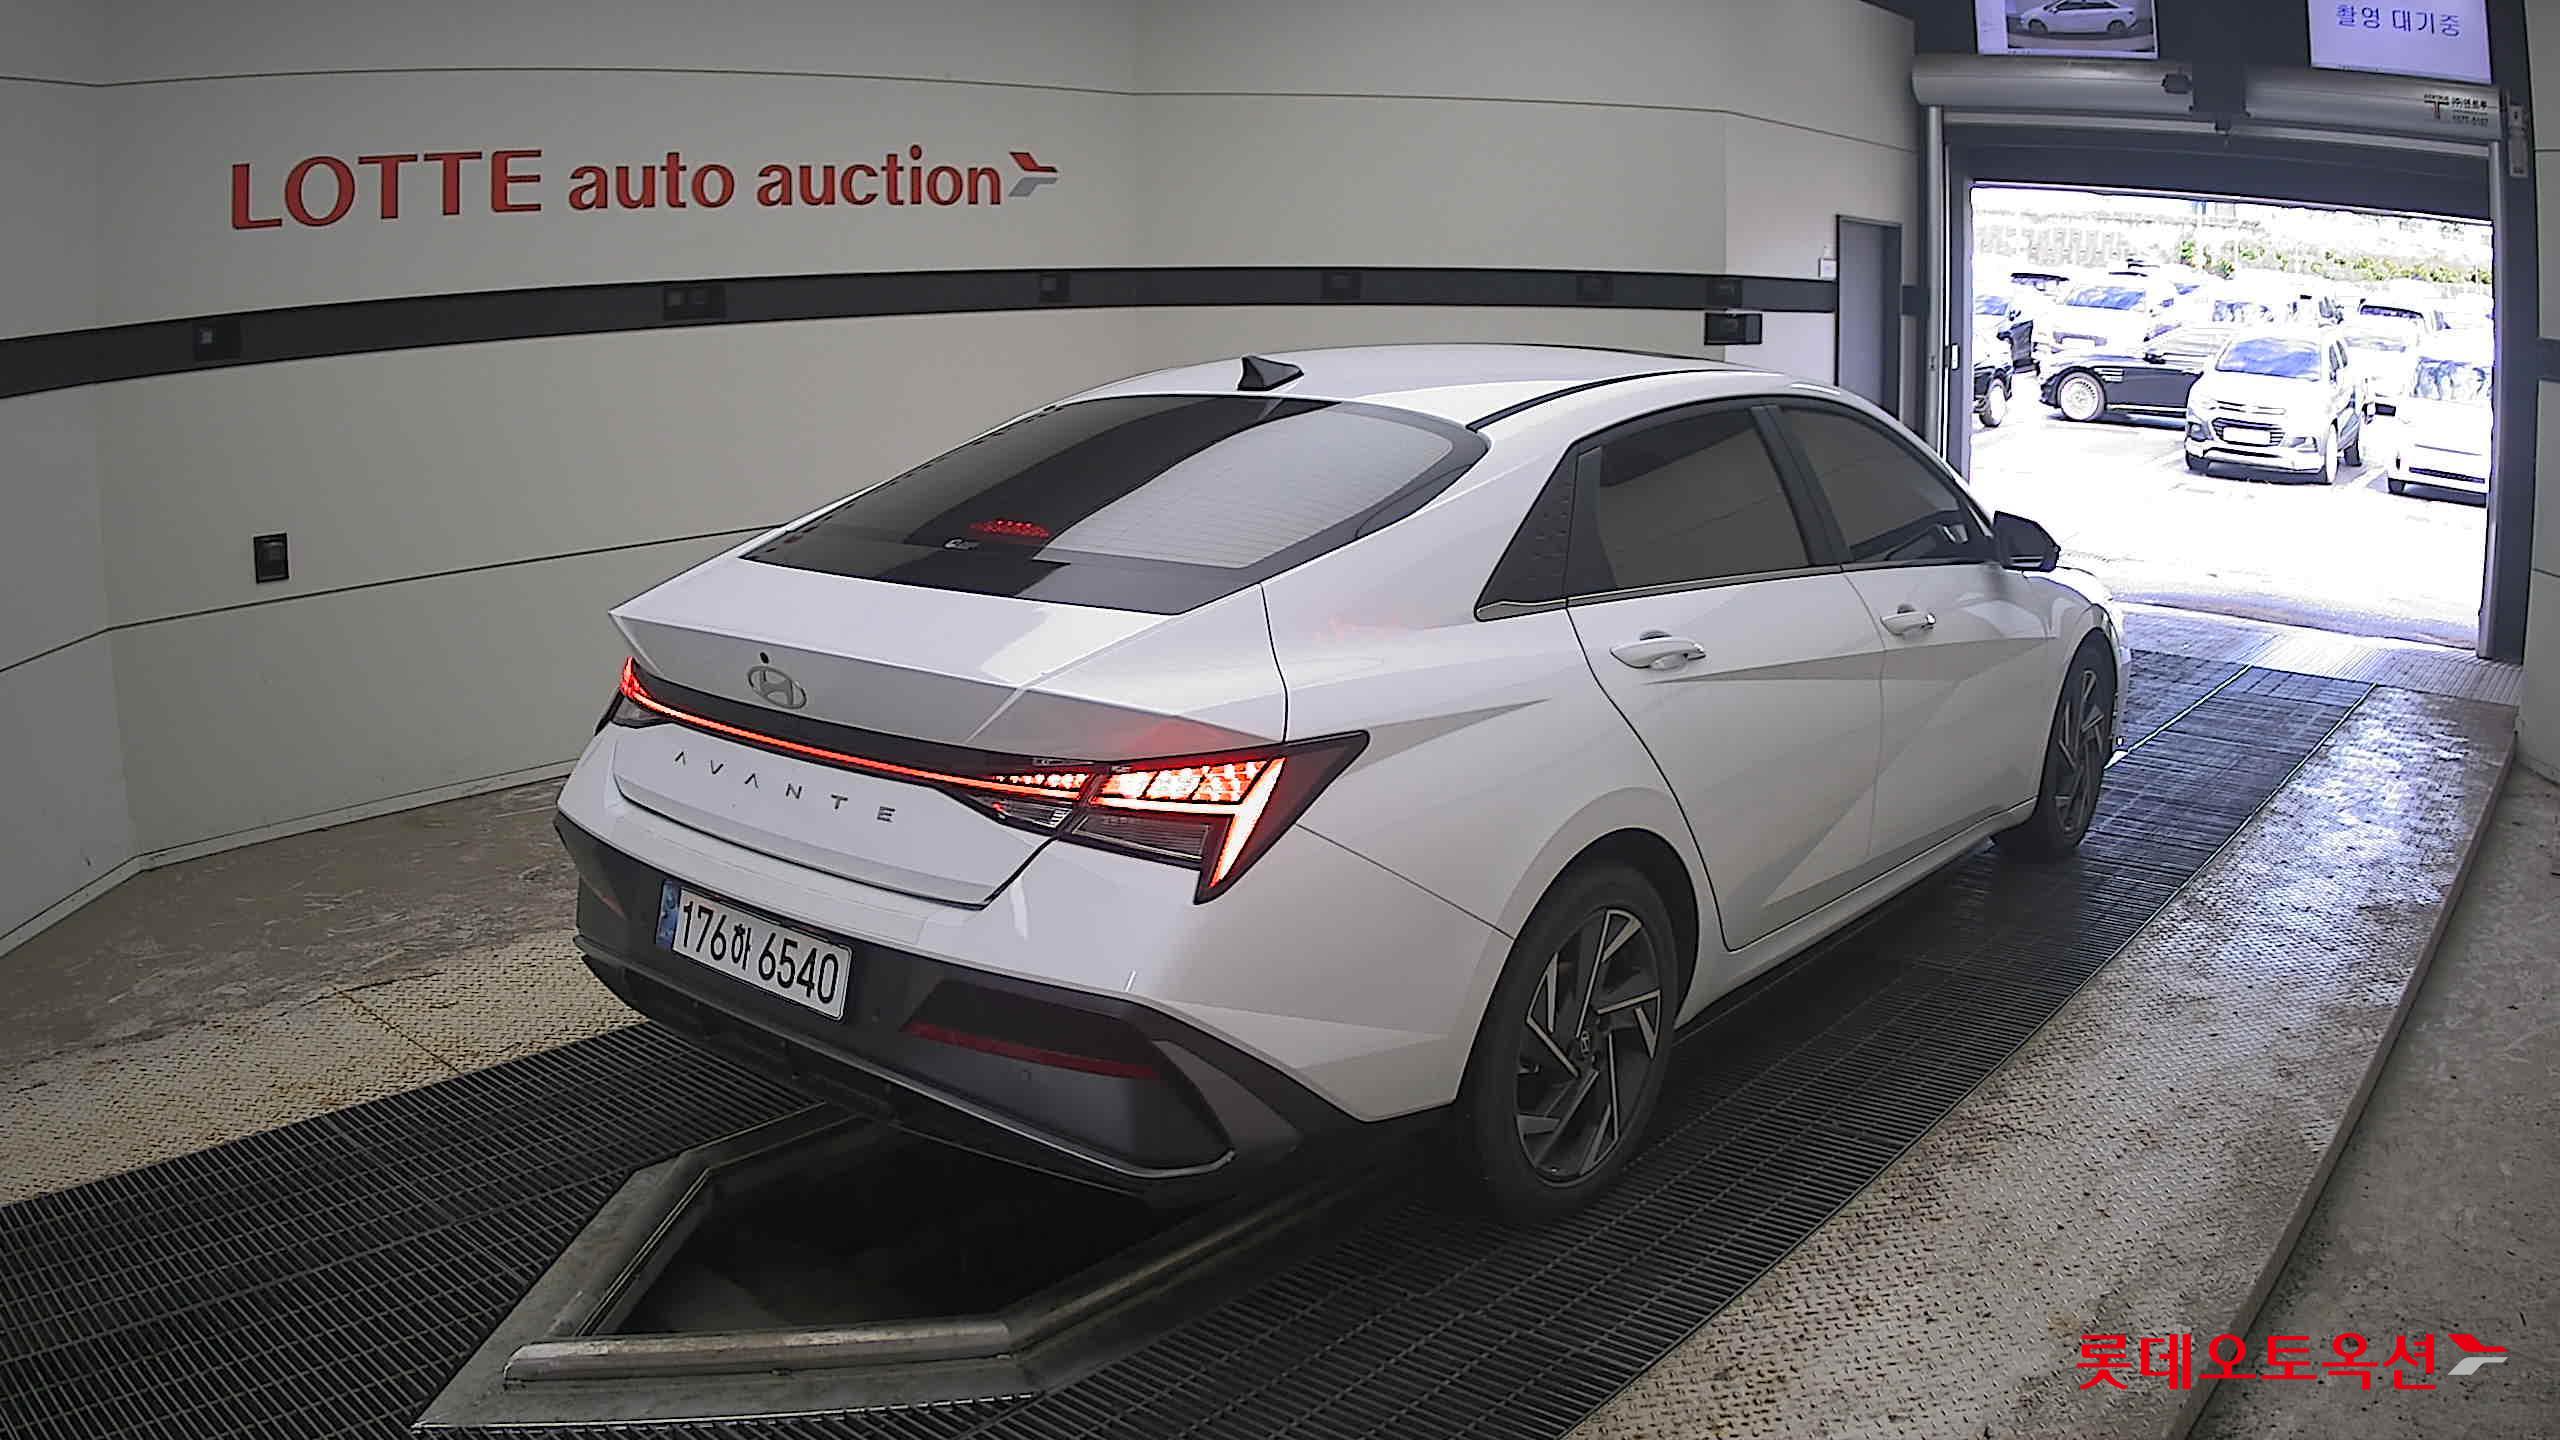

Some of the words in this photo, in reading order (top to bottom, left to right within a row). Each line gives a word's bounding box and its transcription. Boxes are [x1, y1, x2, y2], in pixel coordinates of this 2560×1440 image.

[2337, 4, 2381, 30] 촬영
[2391, 10, 2461, 37] 대기중
[231, 149, 543, 231] LOTTE
[568, 151, 735, 210] auto
[756, 144, 1001, 207] auction
[674, 751, 896, 823] AVANTE
